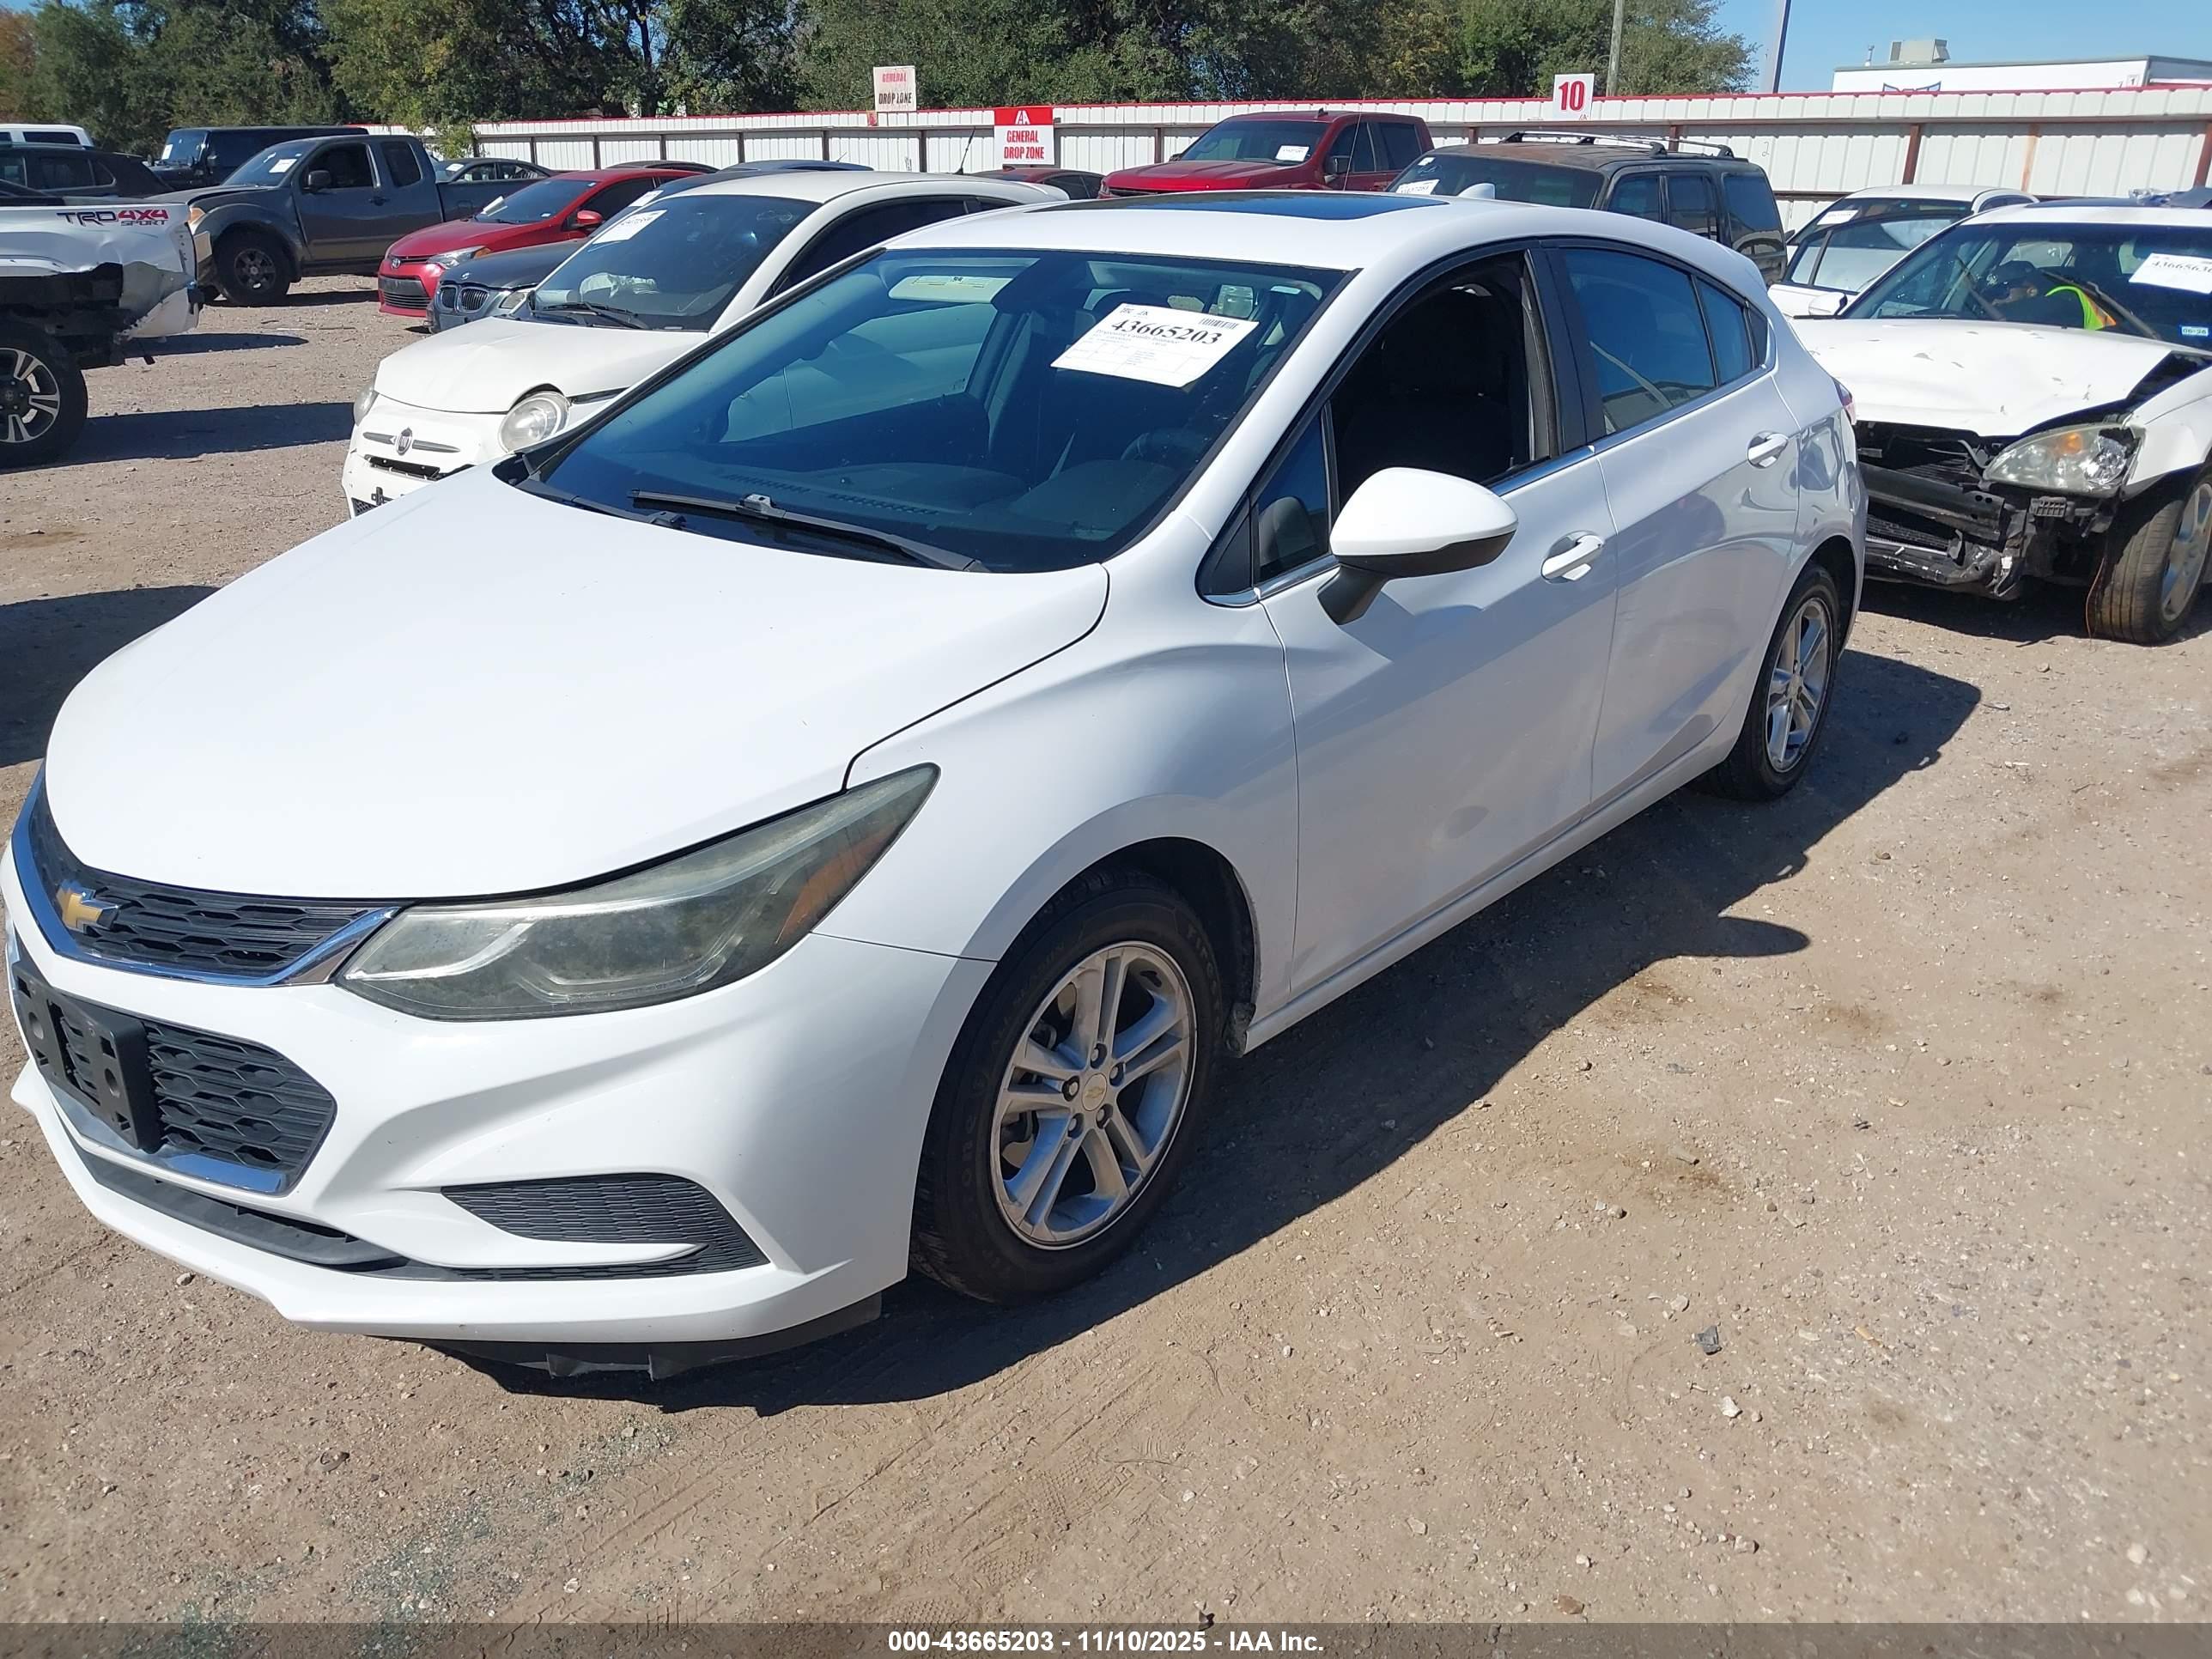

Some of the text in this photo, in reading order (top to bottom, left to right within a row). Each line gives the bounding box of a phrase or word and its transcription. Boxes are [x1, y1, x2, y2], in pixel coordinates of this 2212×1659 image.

[882, 72, 907, 83] GENERAL
[878, 92, 912, 105] DROP ZONE
[1558, 80, 1585, 111] 10
[1006, 130, 1039, 143] GENERAL
[1004, 146, 1045, 160] DROP ZONE
[57, 210, 118, 227] TRD
[1111, 319, 1223, 345] 43665203
